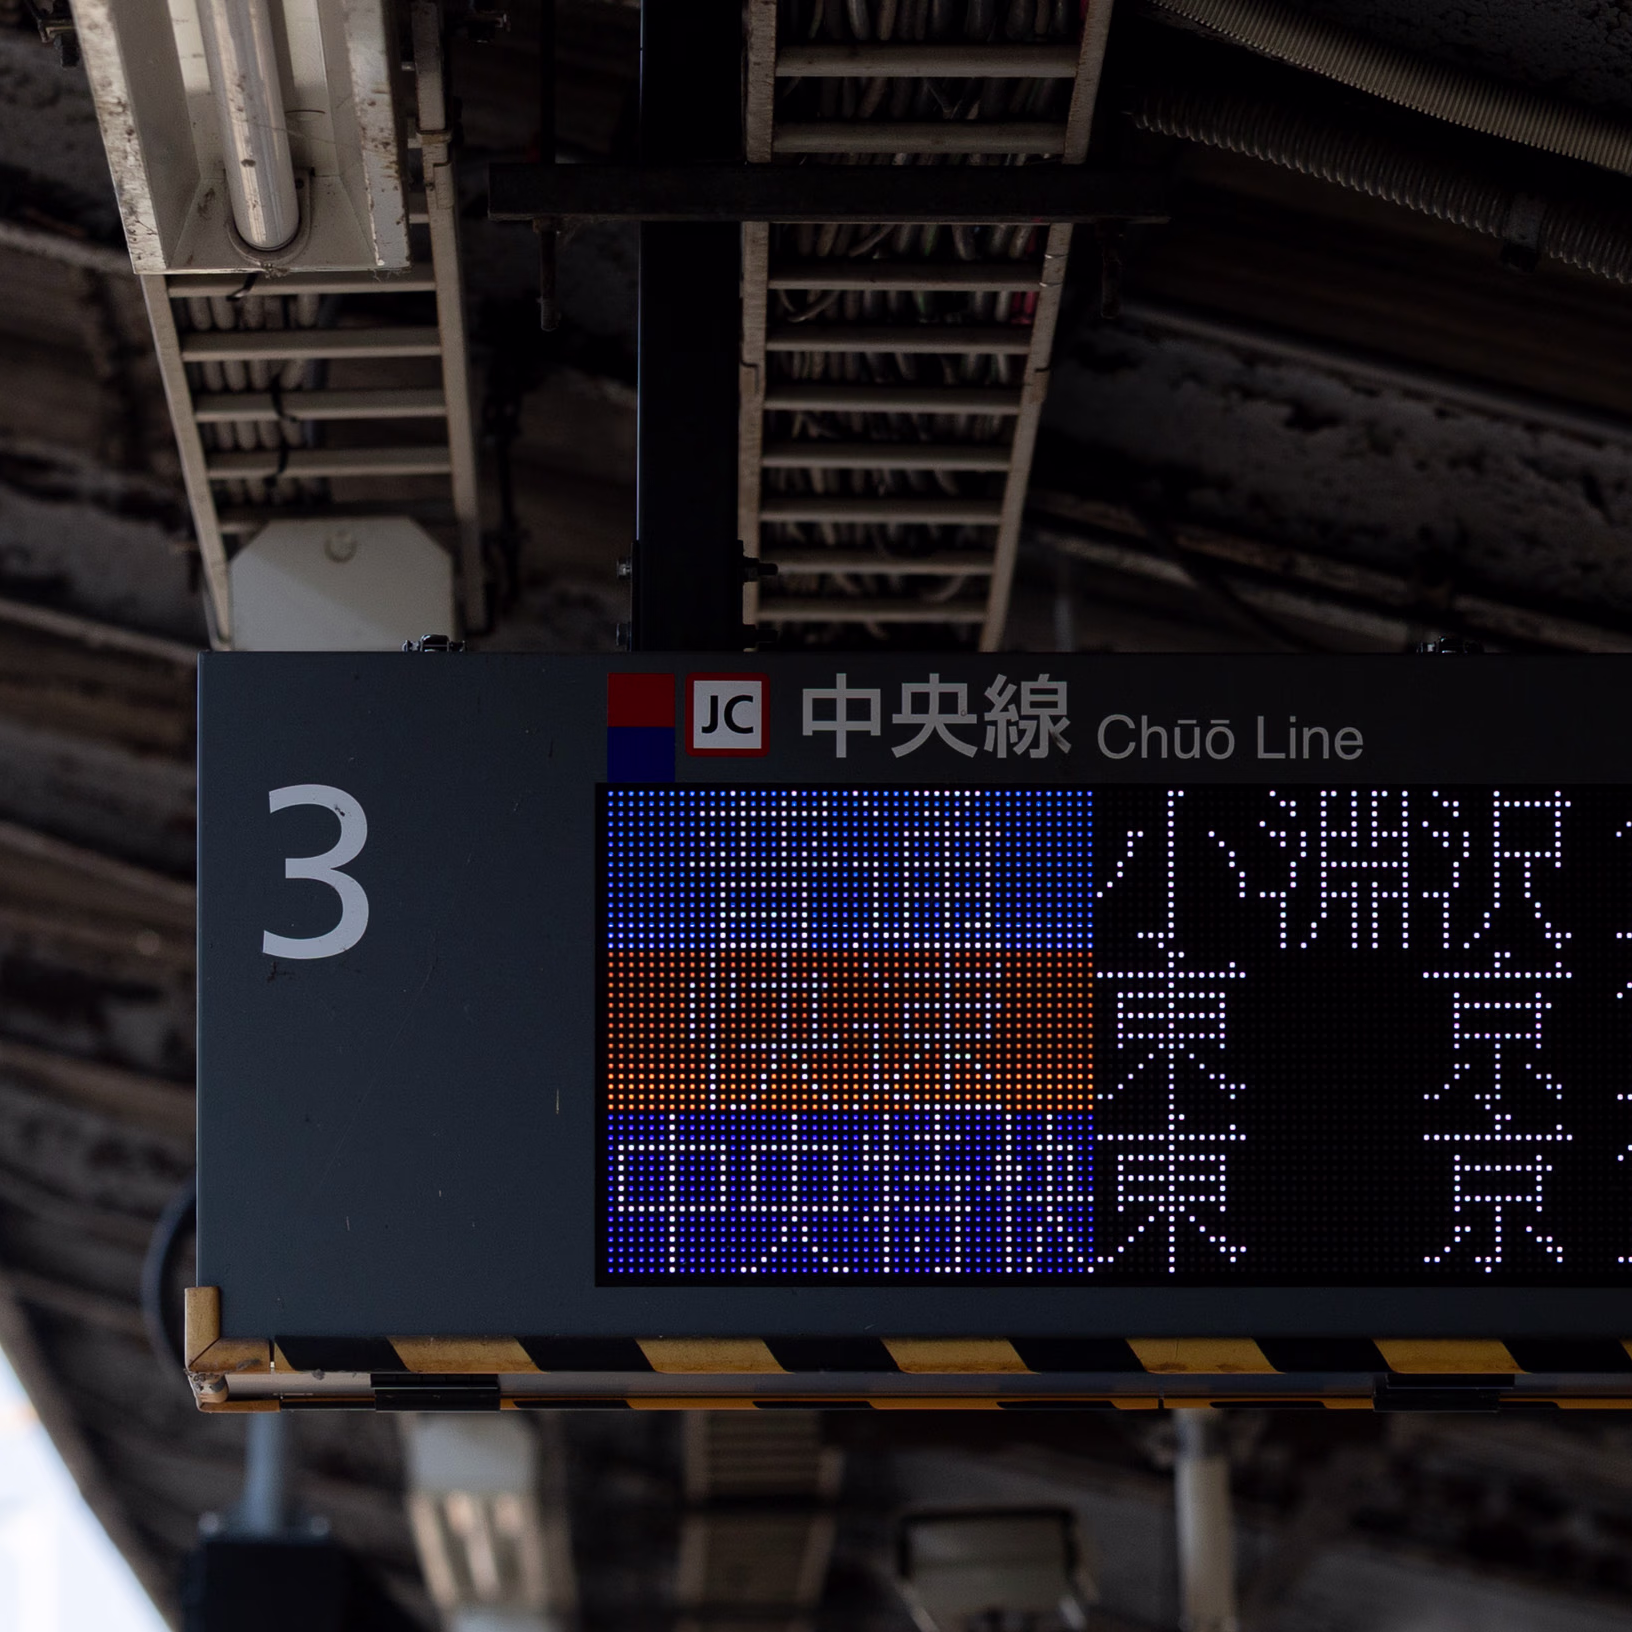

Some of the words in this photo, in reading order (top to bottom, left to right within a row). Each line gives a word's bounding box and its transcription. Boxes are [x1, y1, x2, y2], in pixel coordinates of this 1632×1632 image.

[700, 694, 756, 735] JC
[800, 672, 1072, 760] 中央線
[1096, 713, 1236, 760] Chūō
[1256, 714, 1365, 760] Line
[261, 782, 371, 960] 3
[687, 788, 1004, 950] 普通
[687, 950, 1004, 1111] 快速
[616, 1113, 1094, 1274] 中央特快
